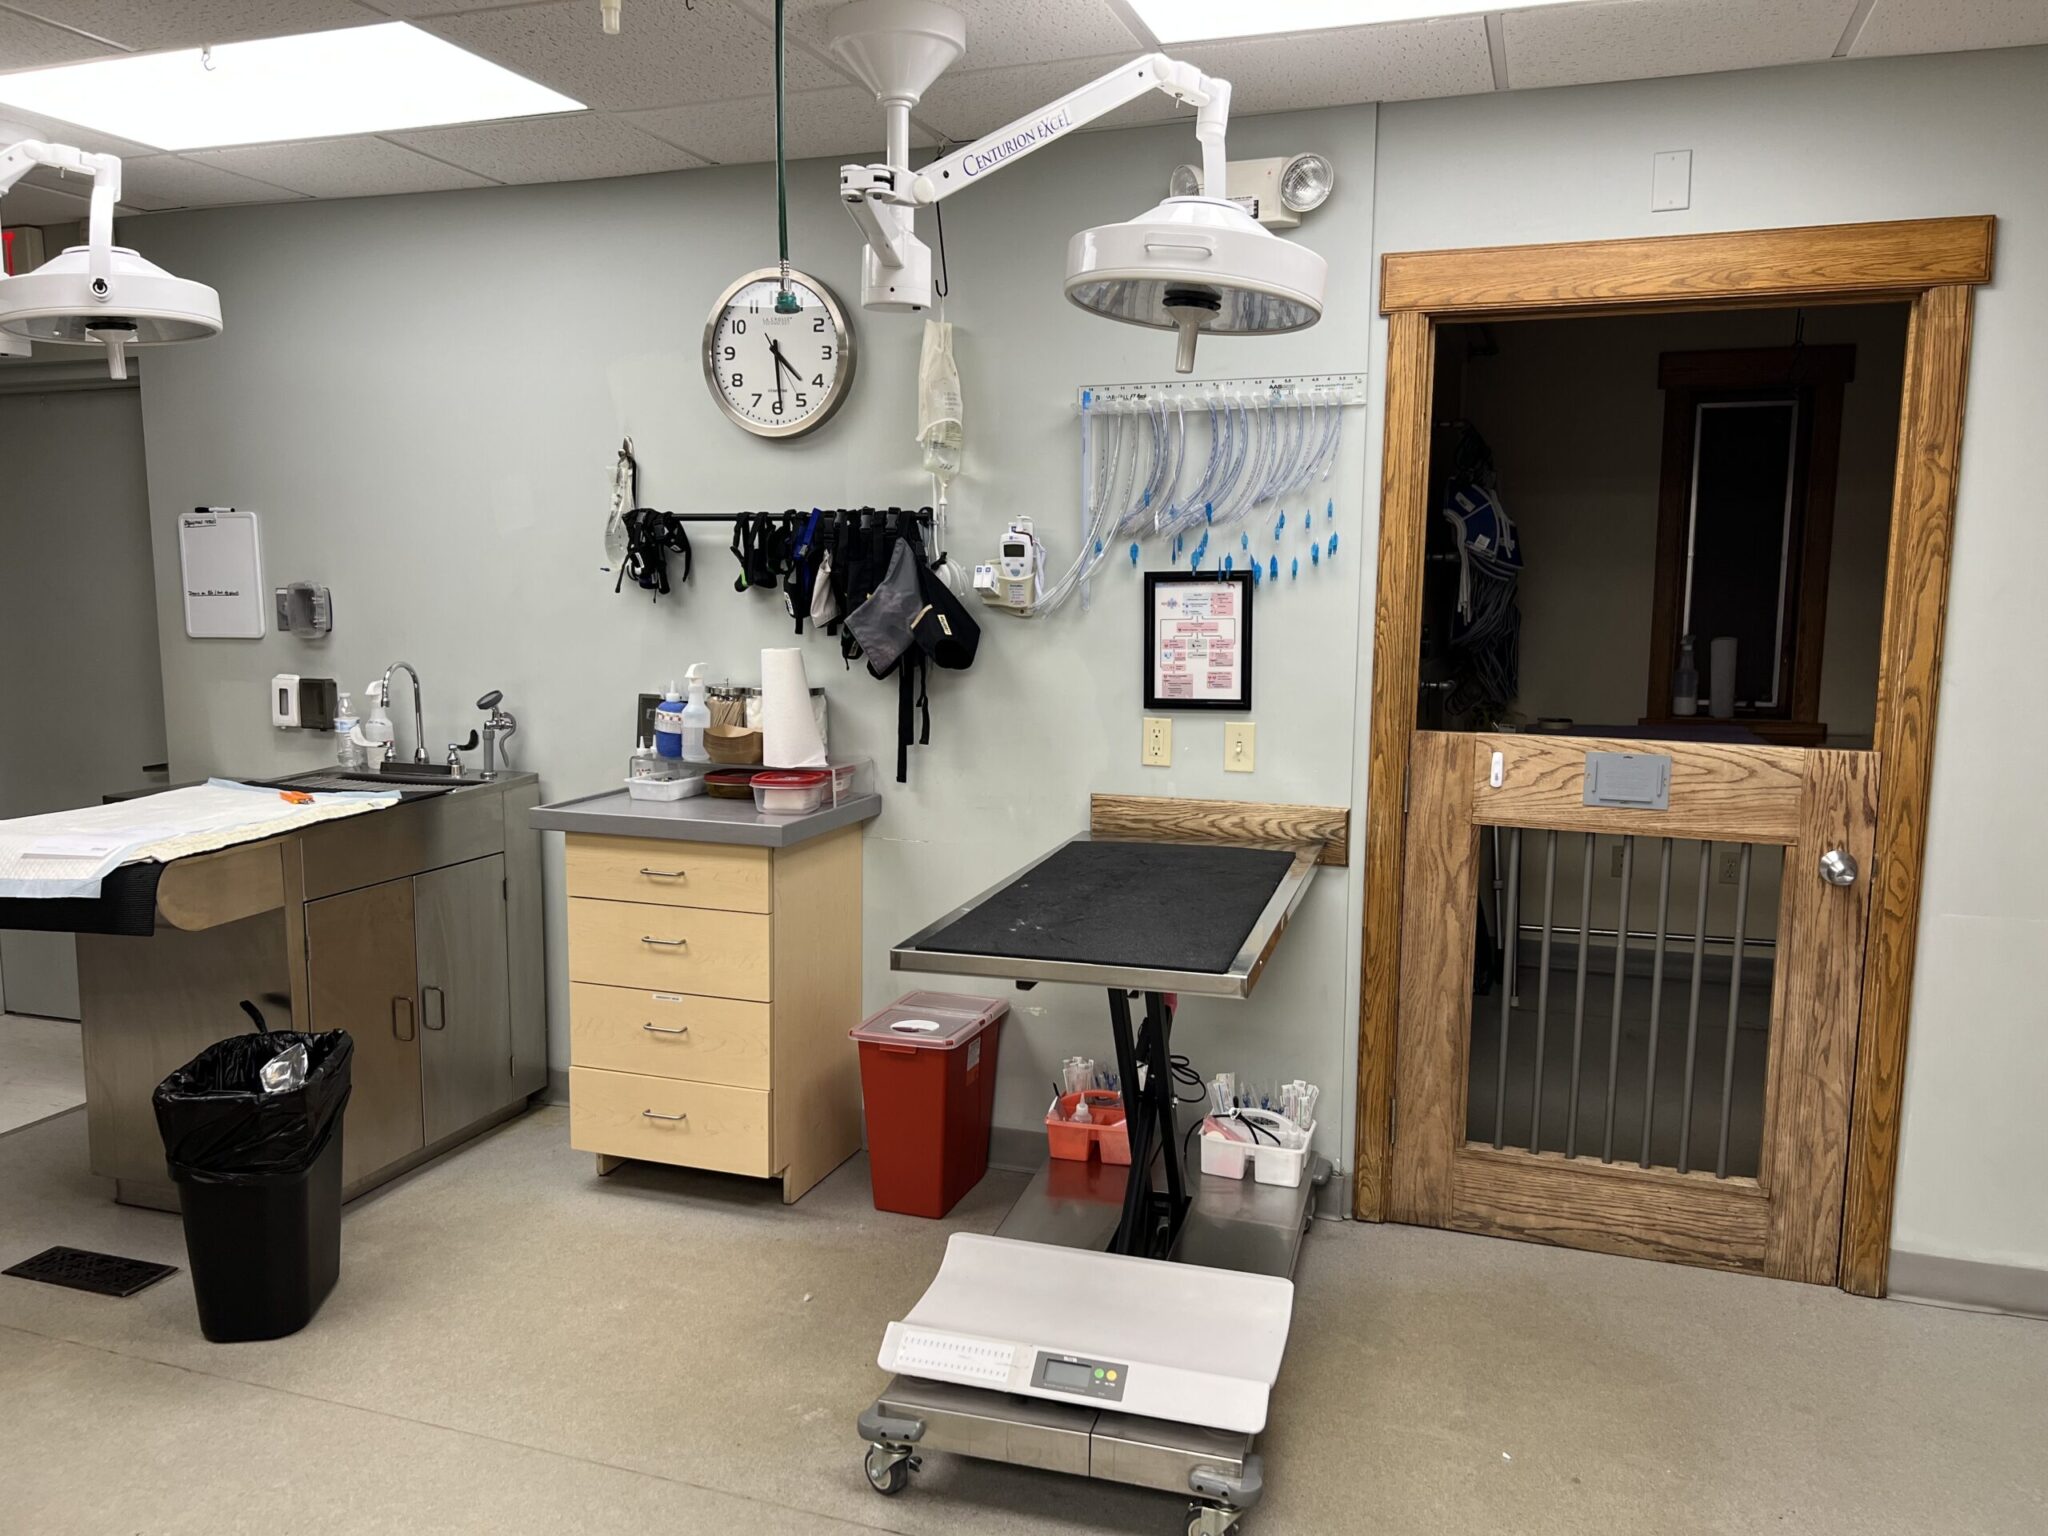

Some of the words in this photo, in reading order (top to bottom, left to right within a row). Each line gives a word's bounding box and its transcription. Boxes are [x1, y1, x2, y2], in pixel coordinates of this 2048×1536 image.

[962, 128, 1036, 177] CENTURION
[1037, 108, 1073, 139] EXCEL
[749, 299, 759, 314] 11
[731, 319, 747, 335] 10
[813, 318, 825, 333] 2
[724, 346, 736, 361] 9
[821, 345, 832, 360] 3
[731, 373, 743, 388] 8
[811, 373, 824, 388] 4
[751, 393, 762, 408] 7
[771, 400, 784, 416] 6
[795, 393, 807, 408] 5
